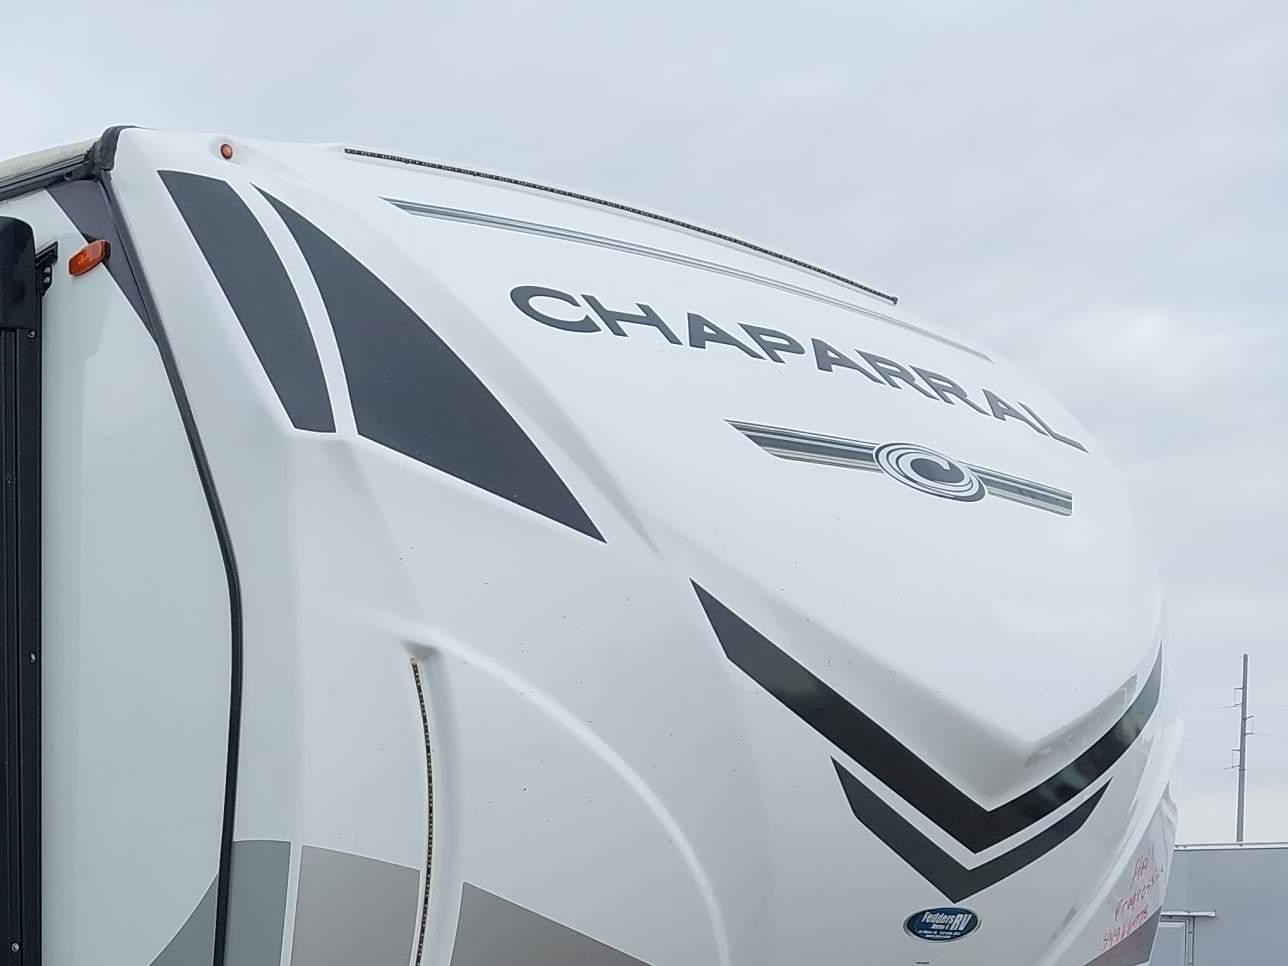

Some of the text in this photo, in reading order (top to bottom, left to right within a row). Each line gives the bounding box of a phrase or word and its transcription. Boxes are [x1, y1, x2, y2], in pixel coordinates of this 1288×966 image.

[510, 285, 1089, 453] CHAPARRAL
[920, 911, 973, 931] Fedders RV
